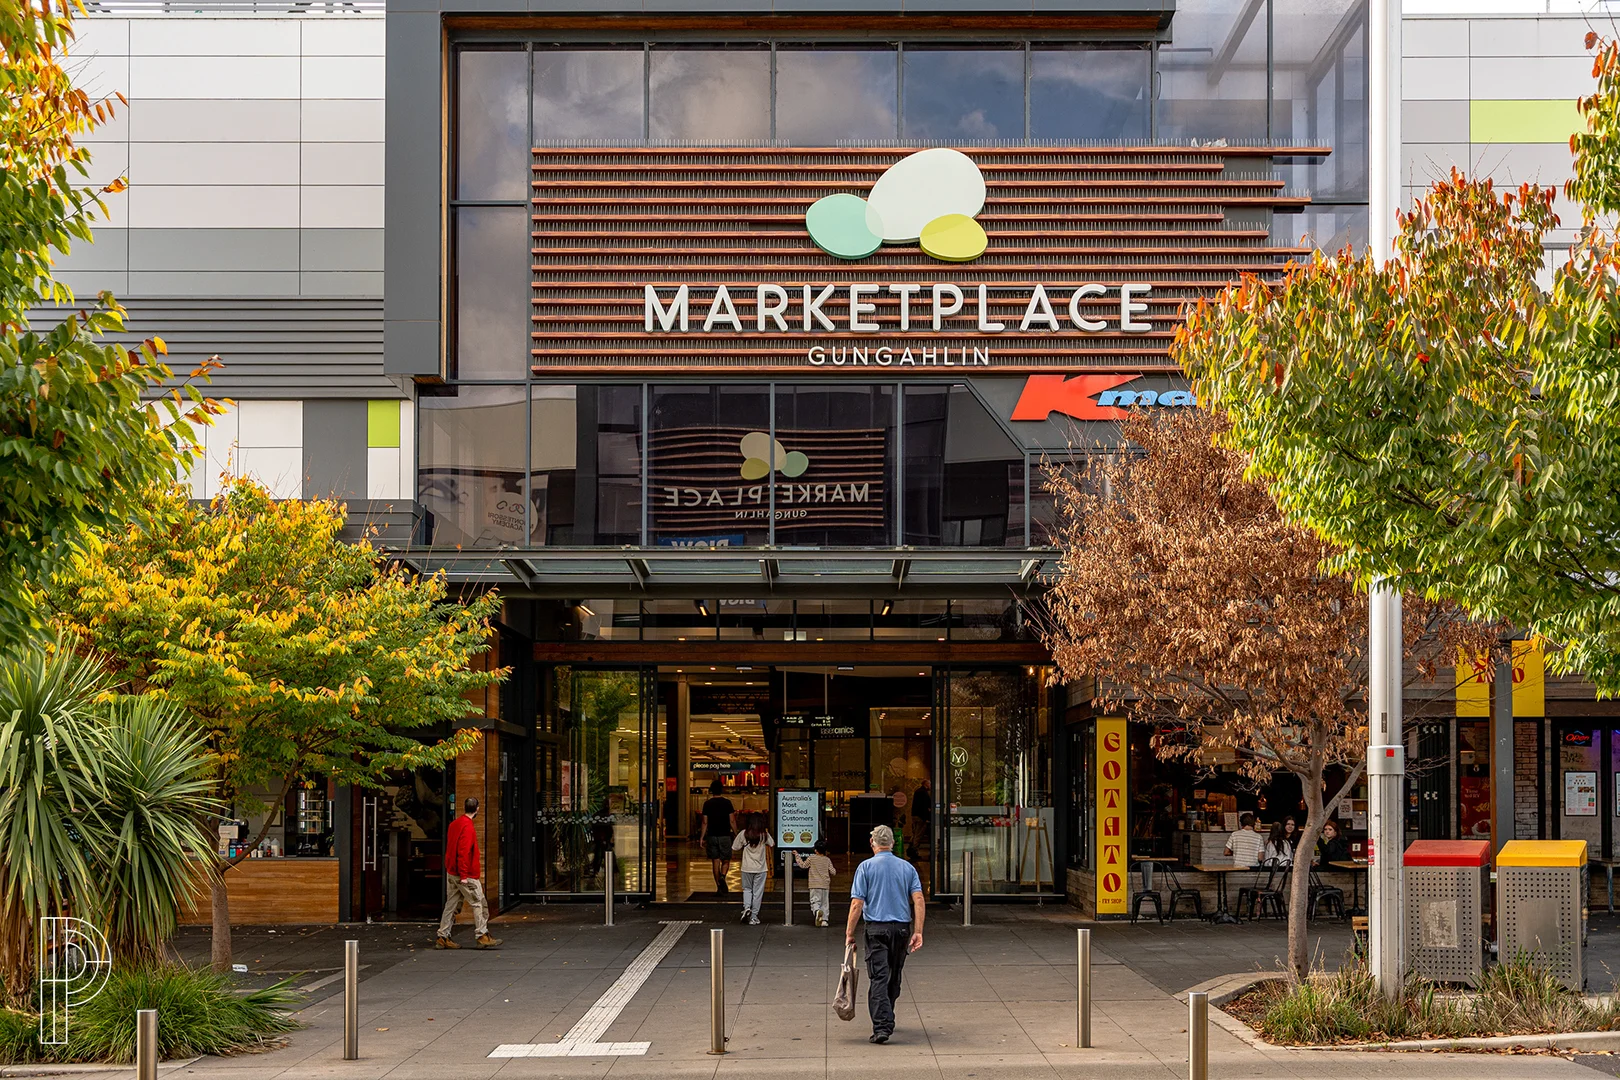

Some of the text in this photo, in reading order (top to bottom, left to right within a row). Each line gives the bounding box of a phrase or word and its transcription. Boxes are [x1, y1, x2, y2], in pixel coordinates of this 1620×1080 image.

[644, 283, 1153, 333] MARKETPLACE
[807, 346, 990, 366] GUNGAHLIN
[1010, 374, 1209, 421] Kma
[1566, 733, 1590, 742] Open
[1103, 732, 1121, 892] GOTATO
